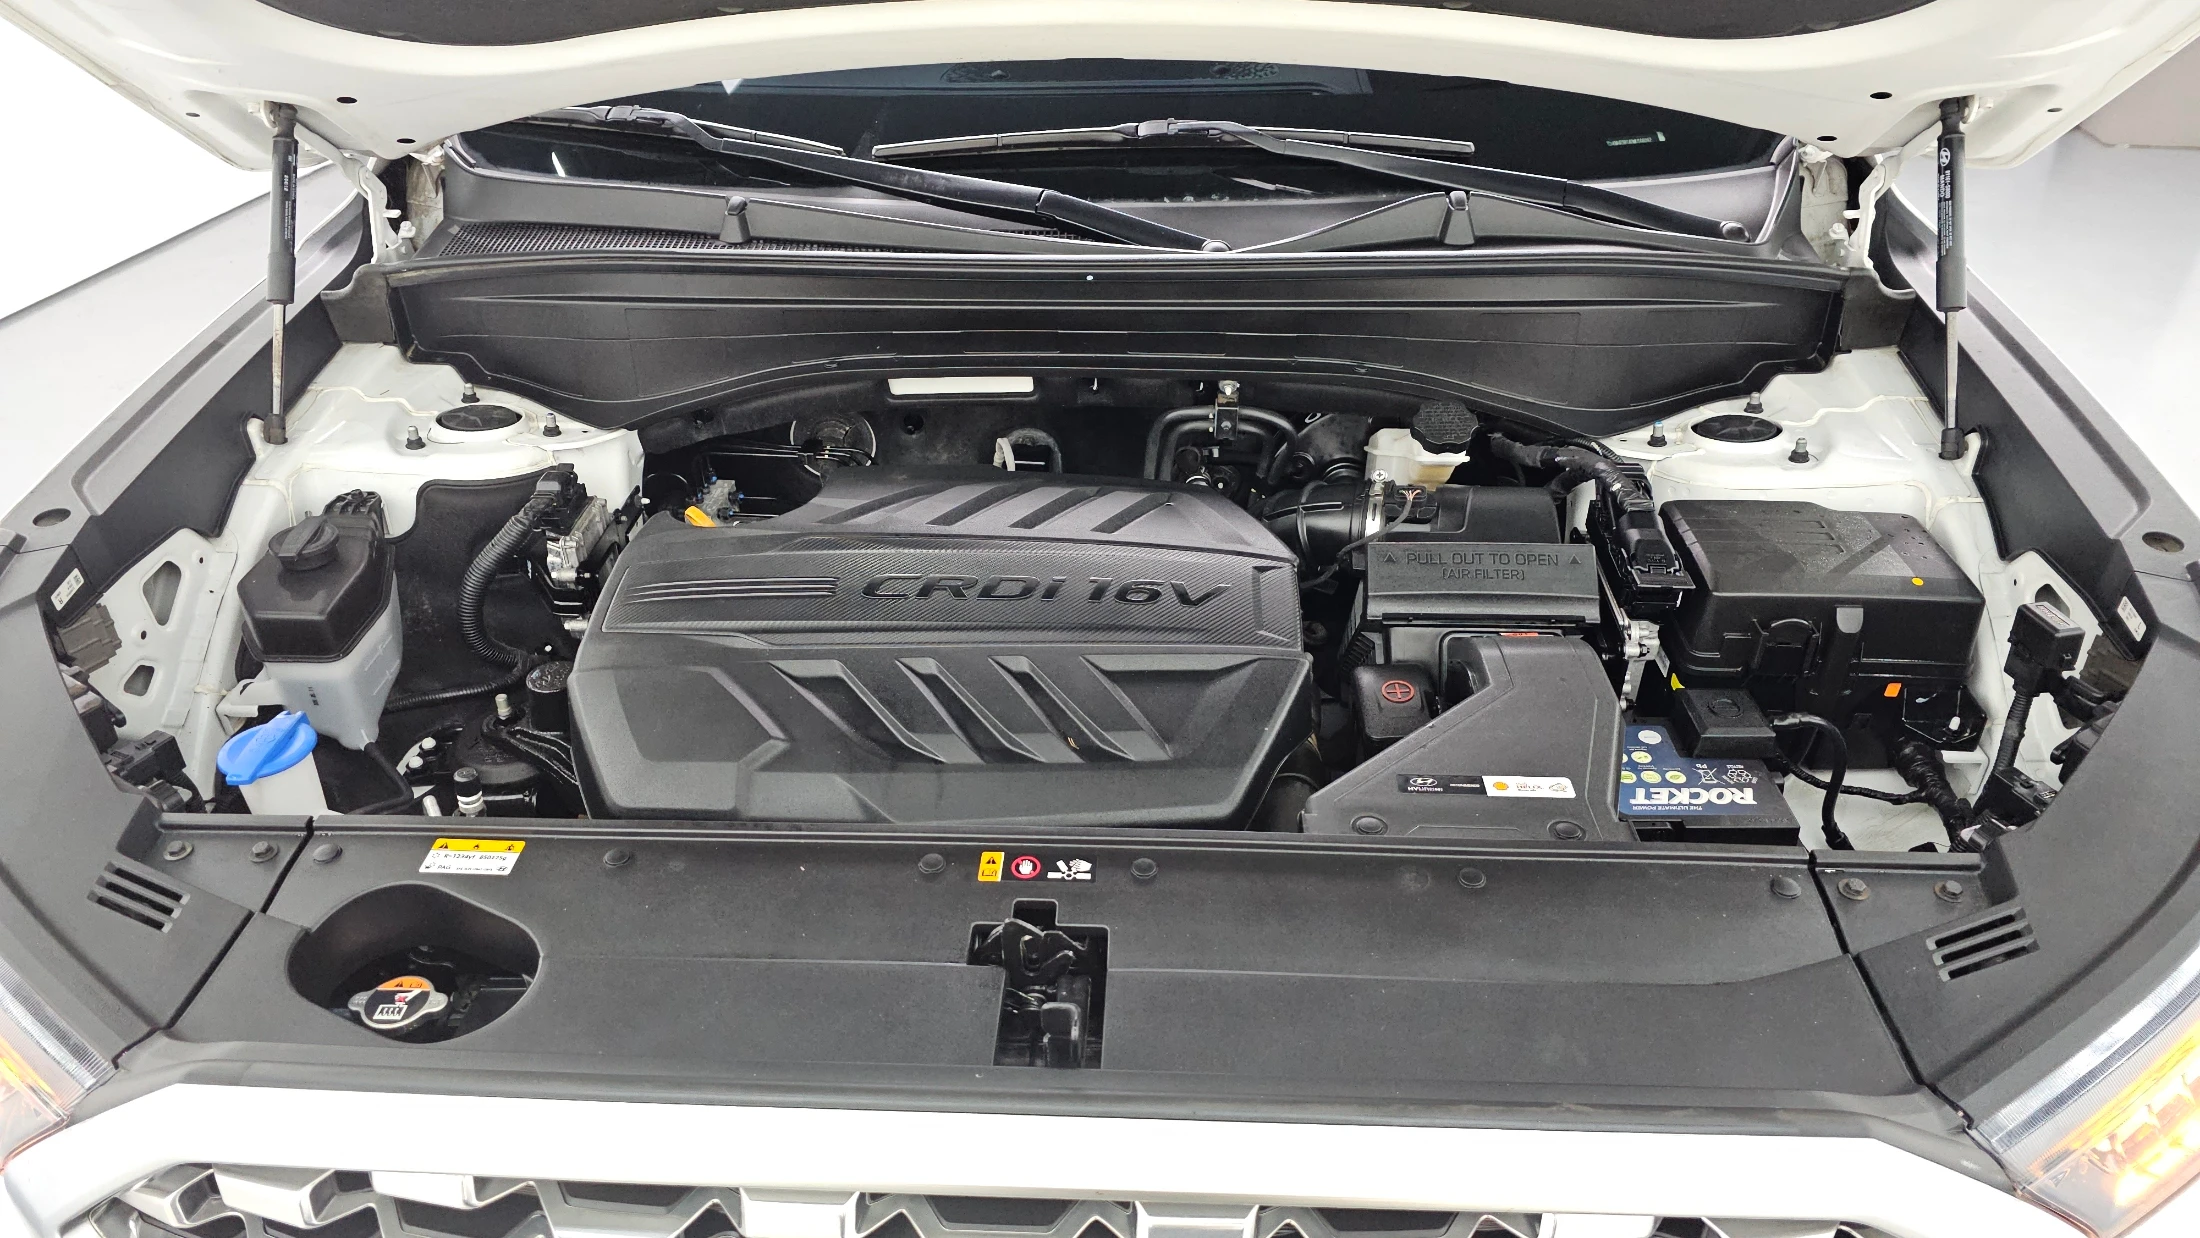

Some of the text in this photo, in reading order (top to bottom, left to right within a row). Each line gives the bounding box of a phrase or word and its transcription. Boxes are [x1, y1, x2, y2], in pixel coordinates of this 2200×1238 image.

[1406, 552, 1559, 566] PULL OUT TO OPEN
[1442, 568, 1525, 581] (AIR FILTER)
[860, 573, 1233, 607] CRDi 16V
[1629, 787, 1757, 805] ROCKET
